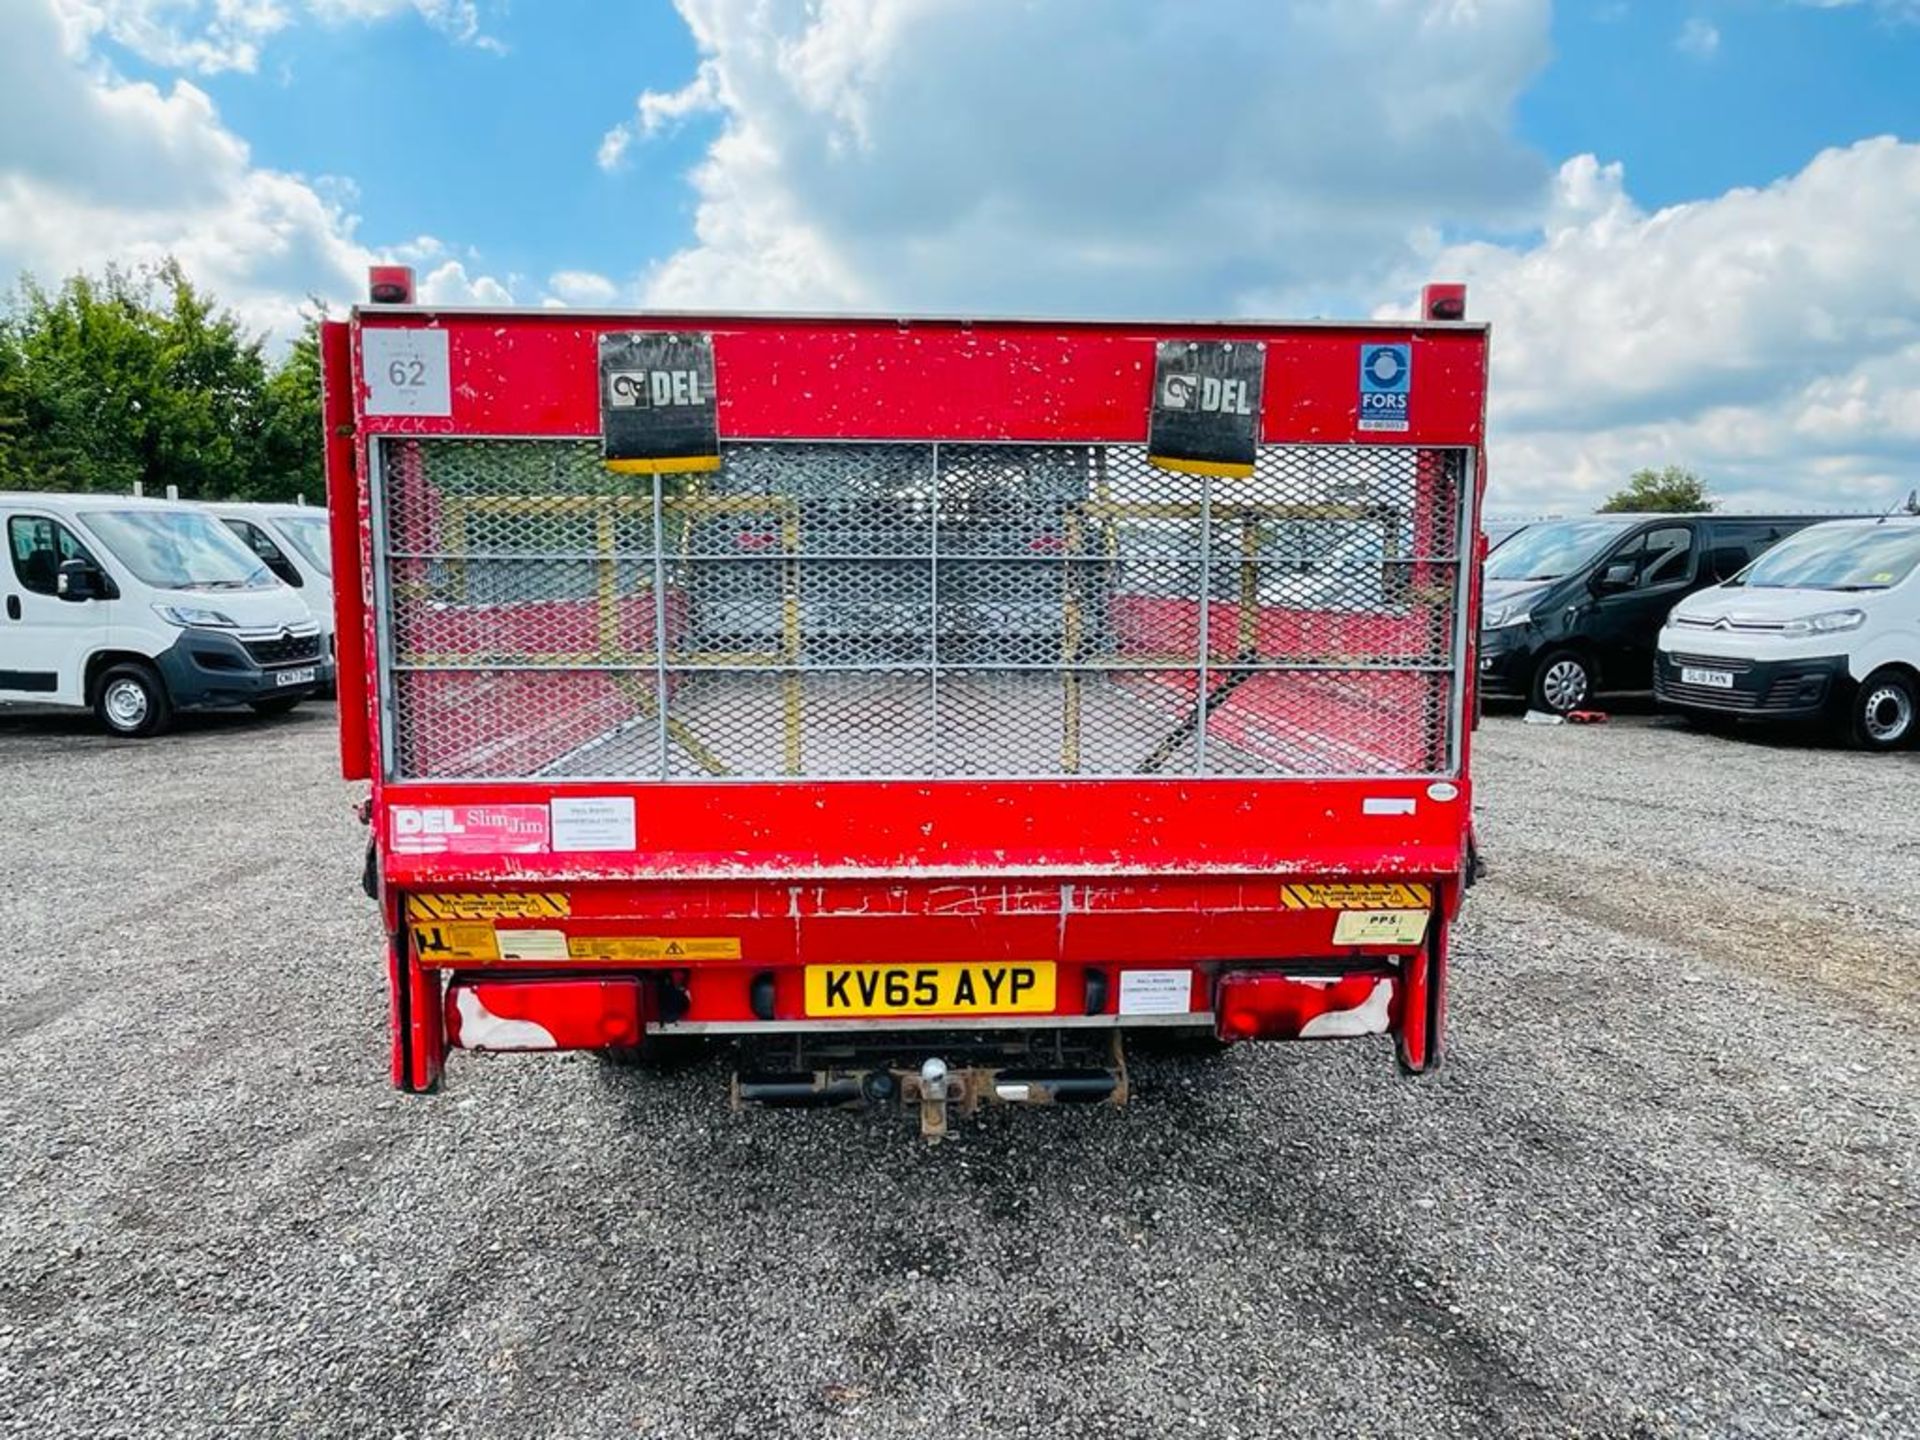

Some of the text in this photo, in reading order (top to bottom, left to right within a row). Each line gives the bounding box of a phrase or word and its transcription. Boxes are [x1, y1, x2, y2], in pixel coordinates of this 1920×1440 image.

[389, 360, 427, 387] 62
[651, 370, 706, 406] DEL
[1201, 377, 1252, 415] DEL
[1362, 393, 1408, 409] FORS
[397, 809, 466, 834] DEL
[466, 809, 508, 827] Slim
[508, 816, 544, 834] Jim
[826, 968, 1036, 1008] KV65 AYP
